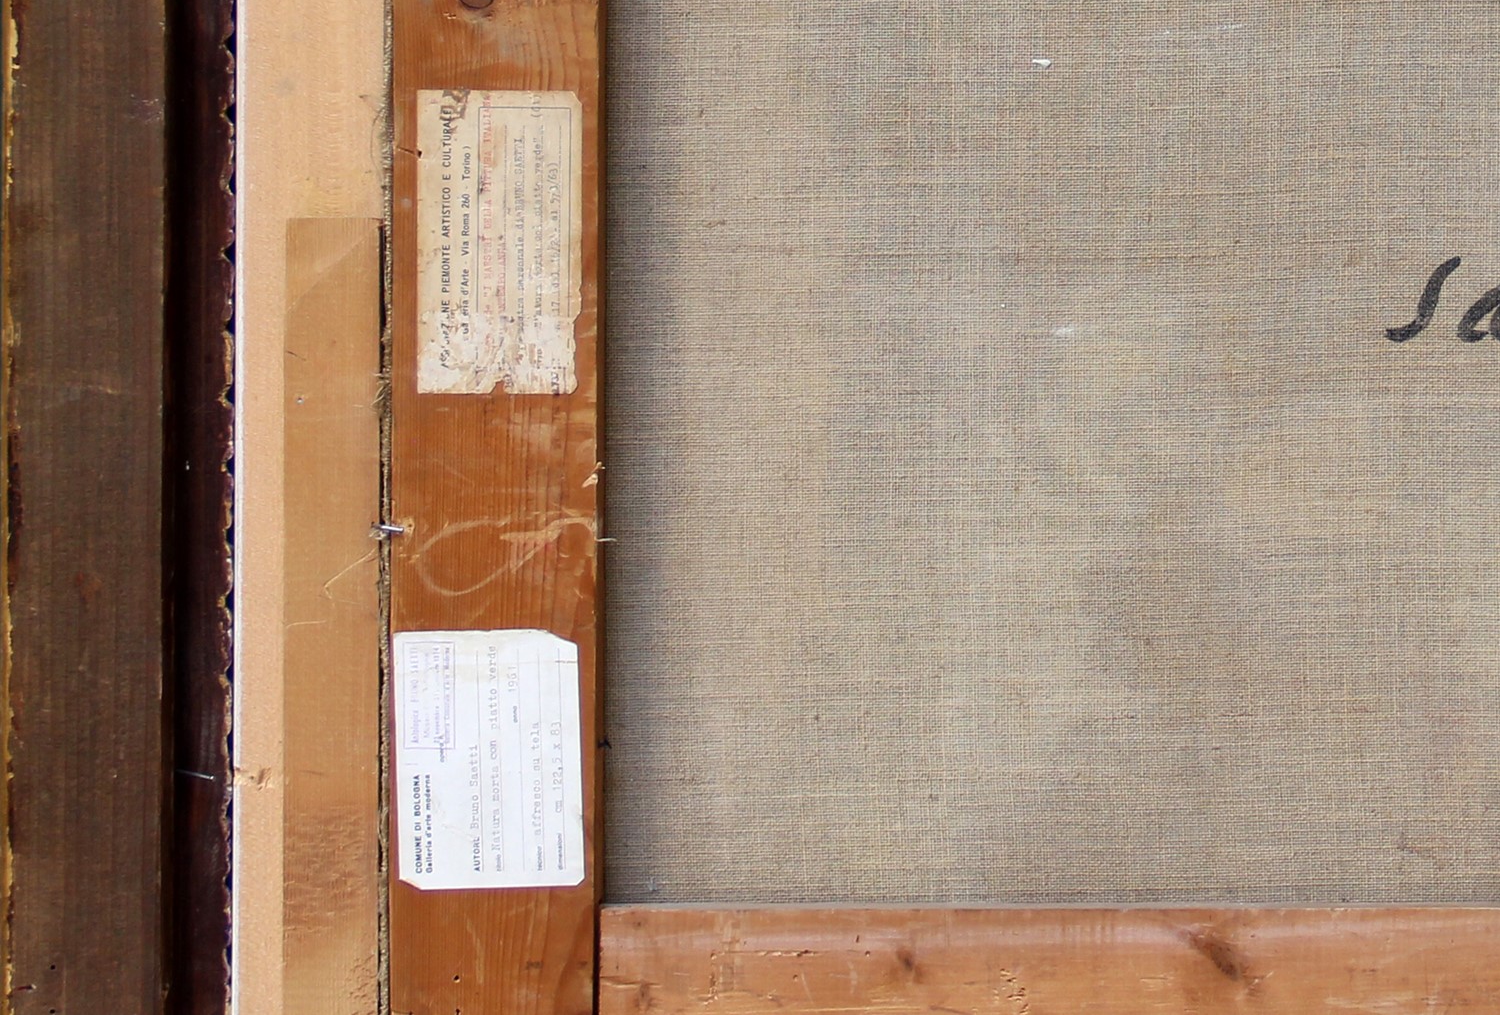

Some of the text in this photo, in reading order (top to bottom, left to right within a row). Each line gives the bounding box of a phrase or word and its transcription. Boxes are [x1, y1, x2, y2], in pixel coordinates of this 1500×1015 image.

[442, 187, 451, 238] ARTISTICO
[462, 194, 470, 208] 260
[442, 245, 450, 293] PIEMONTE
[461, 269, 469, 295] d'Arte
[487, 646, 496, 680] verde
[551, 721, 561, 736] 83
[468, 744, 480, 787] Saetti
[488, 739, 500, 761] con
[490, 766, 500, 802] morta
[530, 722, 542, 836] affresco su tela
[552, 757, 563, 791] 122,5
[469, 794, 479, 829] Bruno
[555, 800, 562, 813] cm
[413, 775, 423, 874] COMUNE DI BOLOGNA
[491, 809, 501, 851] Natura
[424, 841, 433, 873] Galleria
